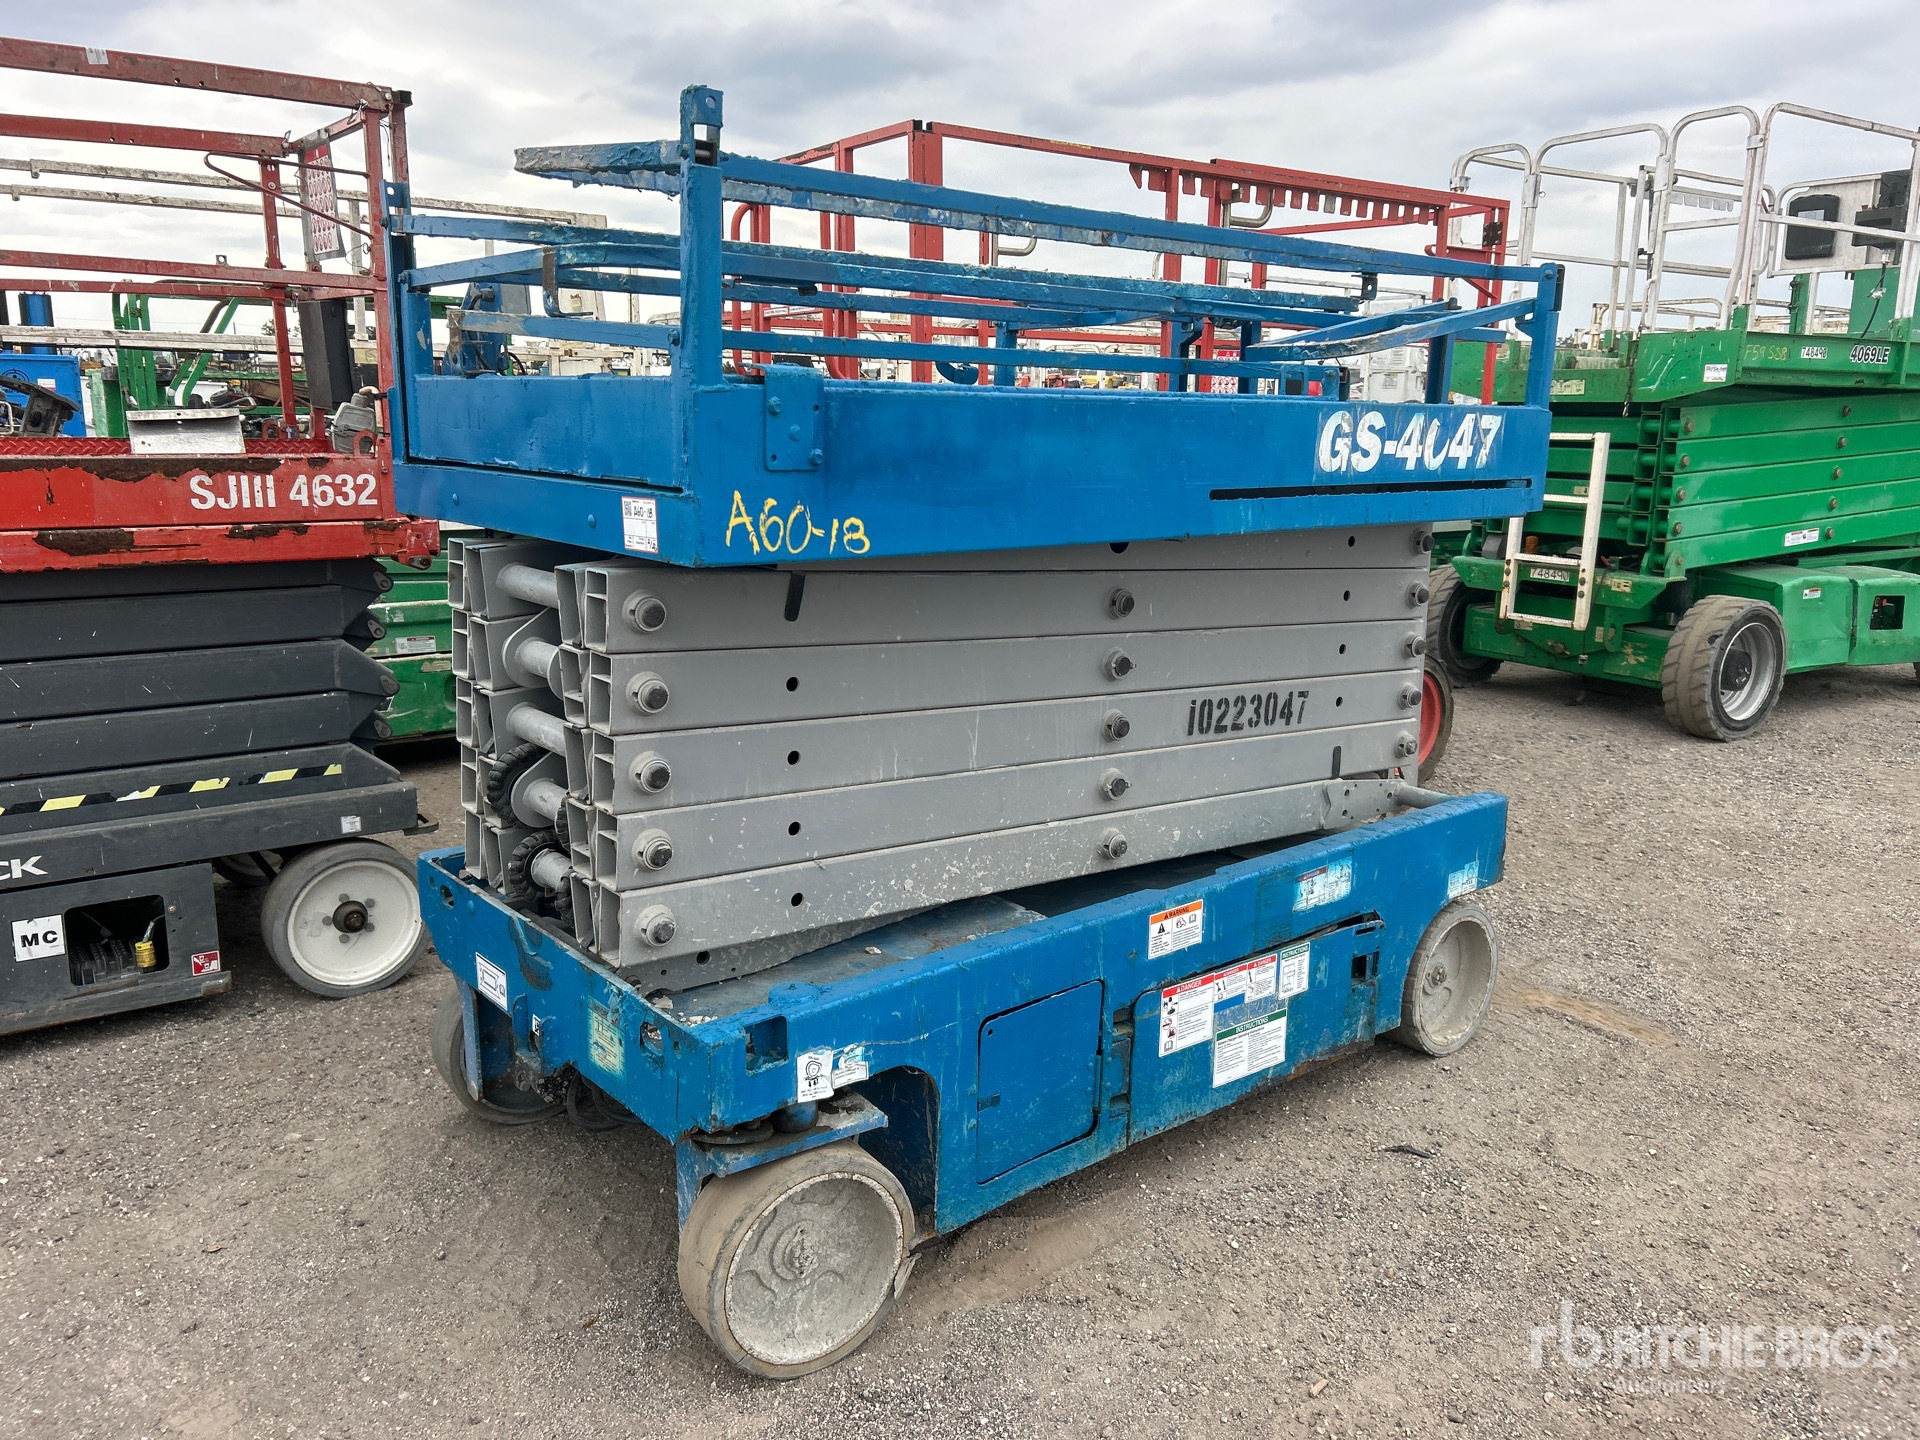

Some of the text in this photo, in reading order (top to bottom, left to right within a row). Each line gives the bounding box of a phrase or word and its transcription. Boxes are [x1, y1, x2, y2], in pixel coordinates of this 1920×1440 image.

[1850, 344, 1890, 363] 4069LE
[1318, 410, 1502, 472] GS-4047
[289, 473, 378, 508] 4632
[725, 490, 871, 555] A60-18
[1531, 567, 1569, 581] 748490
[1168, 906, 1190, 919] WARNING
[20, 930, 58, 948] MC
[1282, 945, 1309, 958] INSTRUCTIONS
[1180, 979, 1202, 992] DANGER
[1236, 1017, 1269, 1033] INSTRUCTIONS
